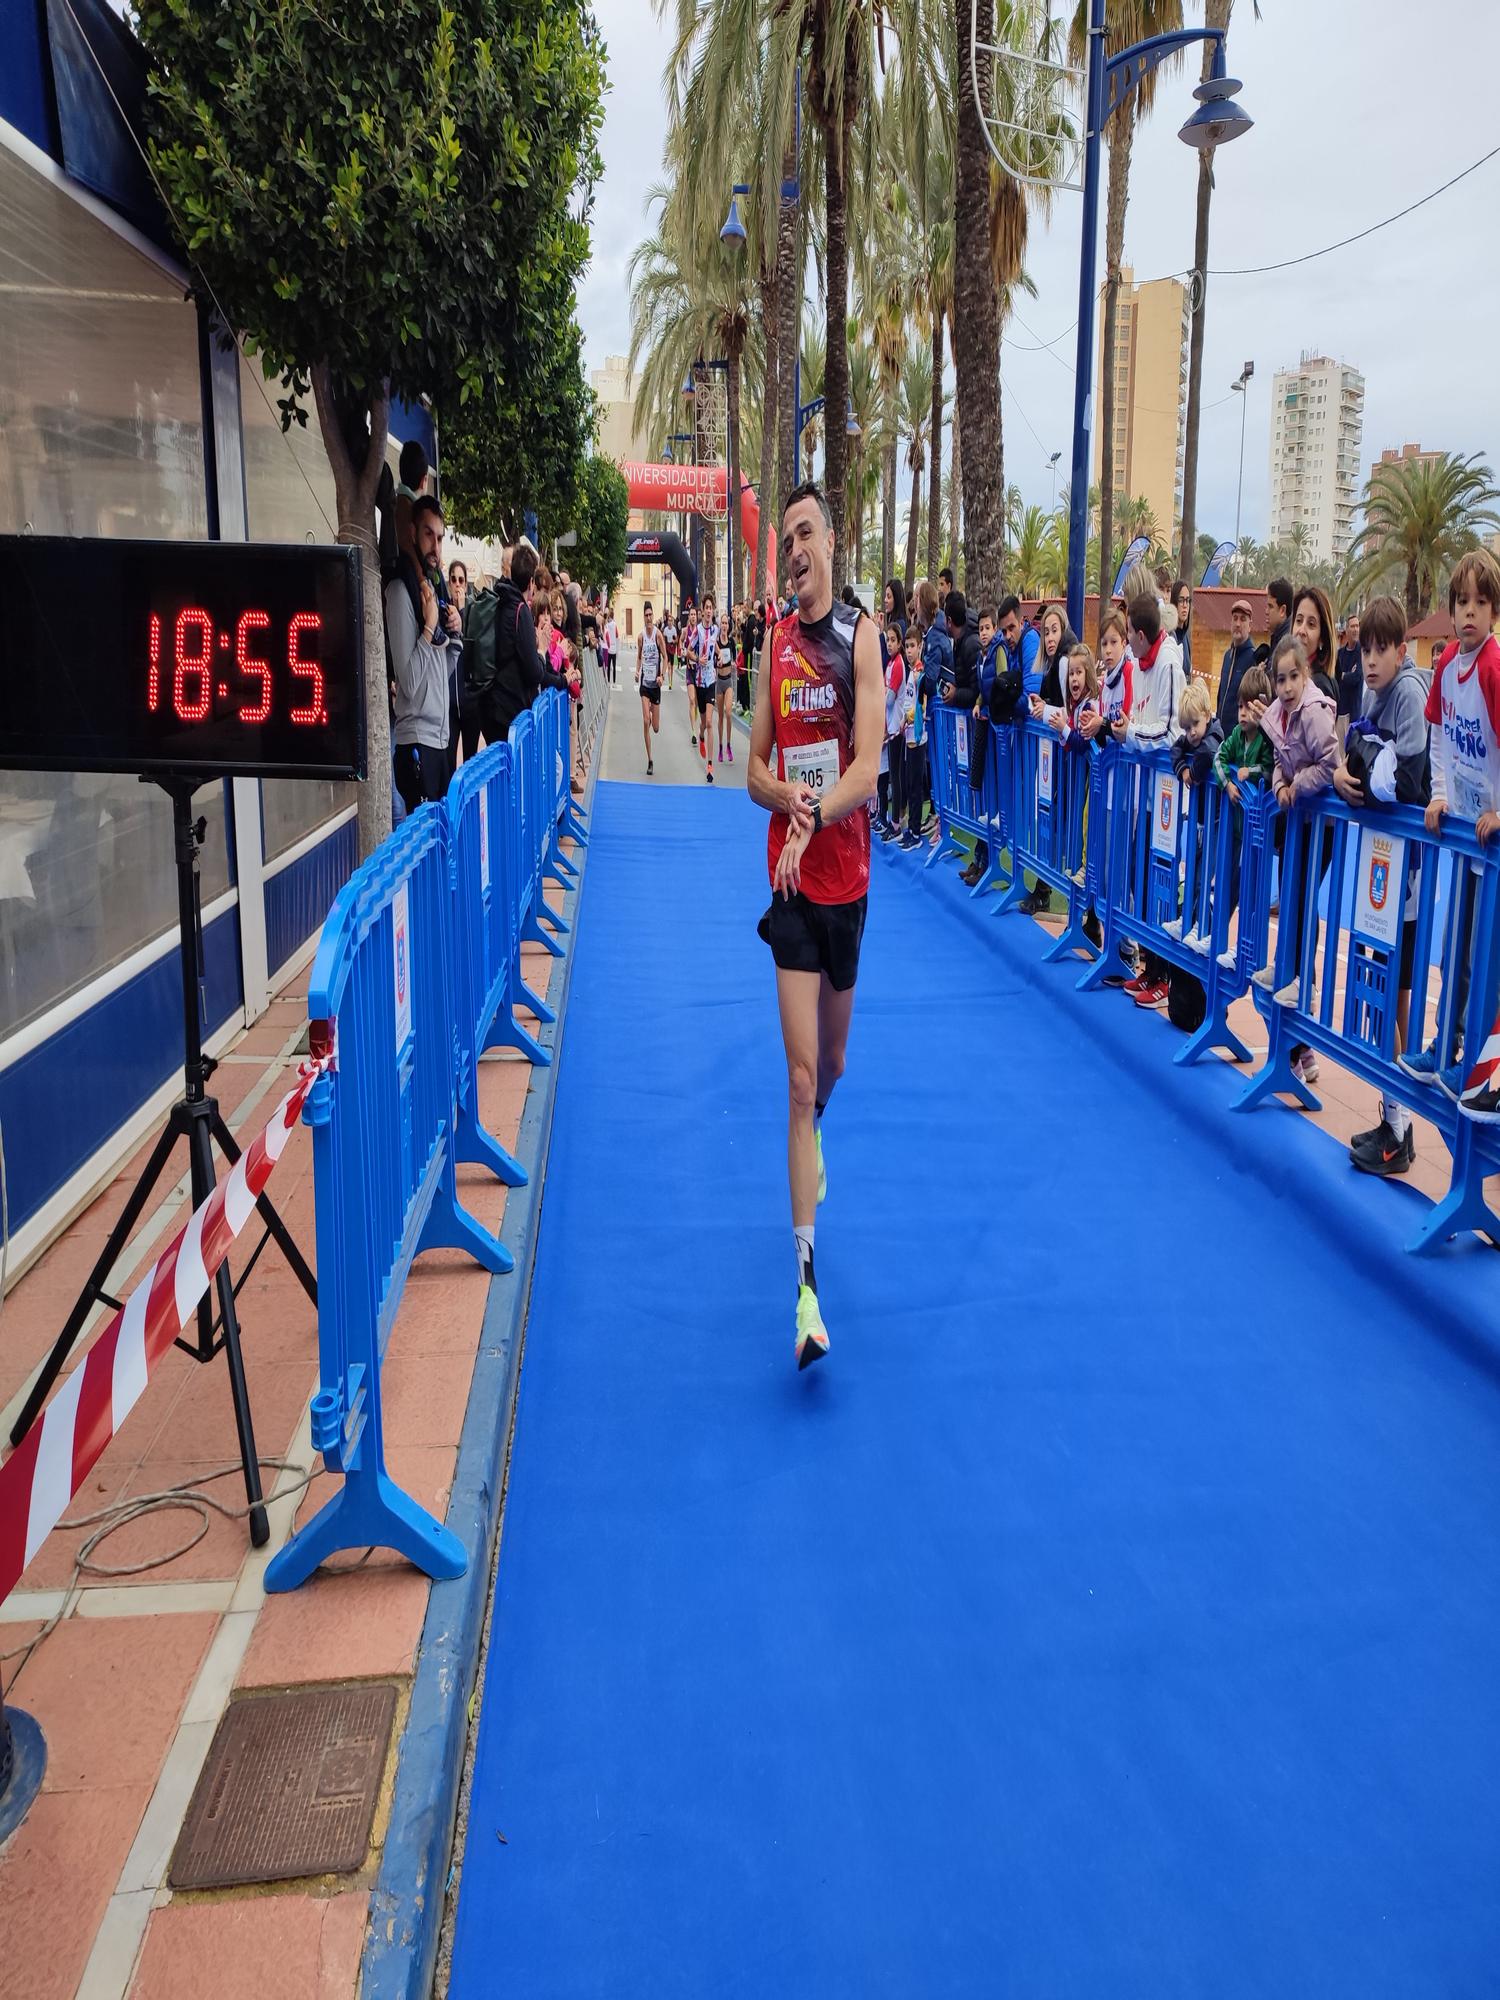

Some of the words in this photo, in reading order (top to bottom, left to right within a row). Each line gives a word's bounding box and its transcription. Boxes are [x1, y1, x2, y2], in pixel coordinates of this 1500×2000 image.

[624, 466, 696, 487] NIVERSIDAD
[700, 471, 716, 488] DE
[667, 492, 715, 511] MURCIA
